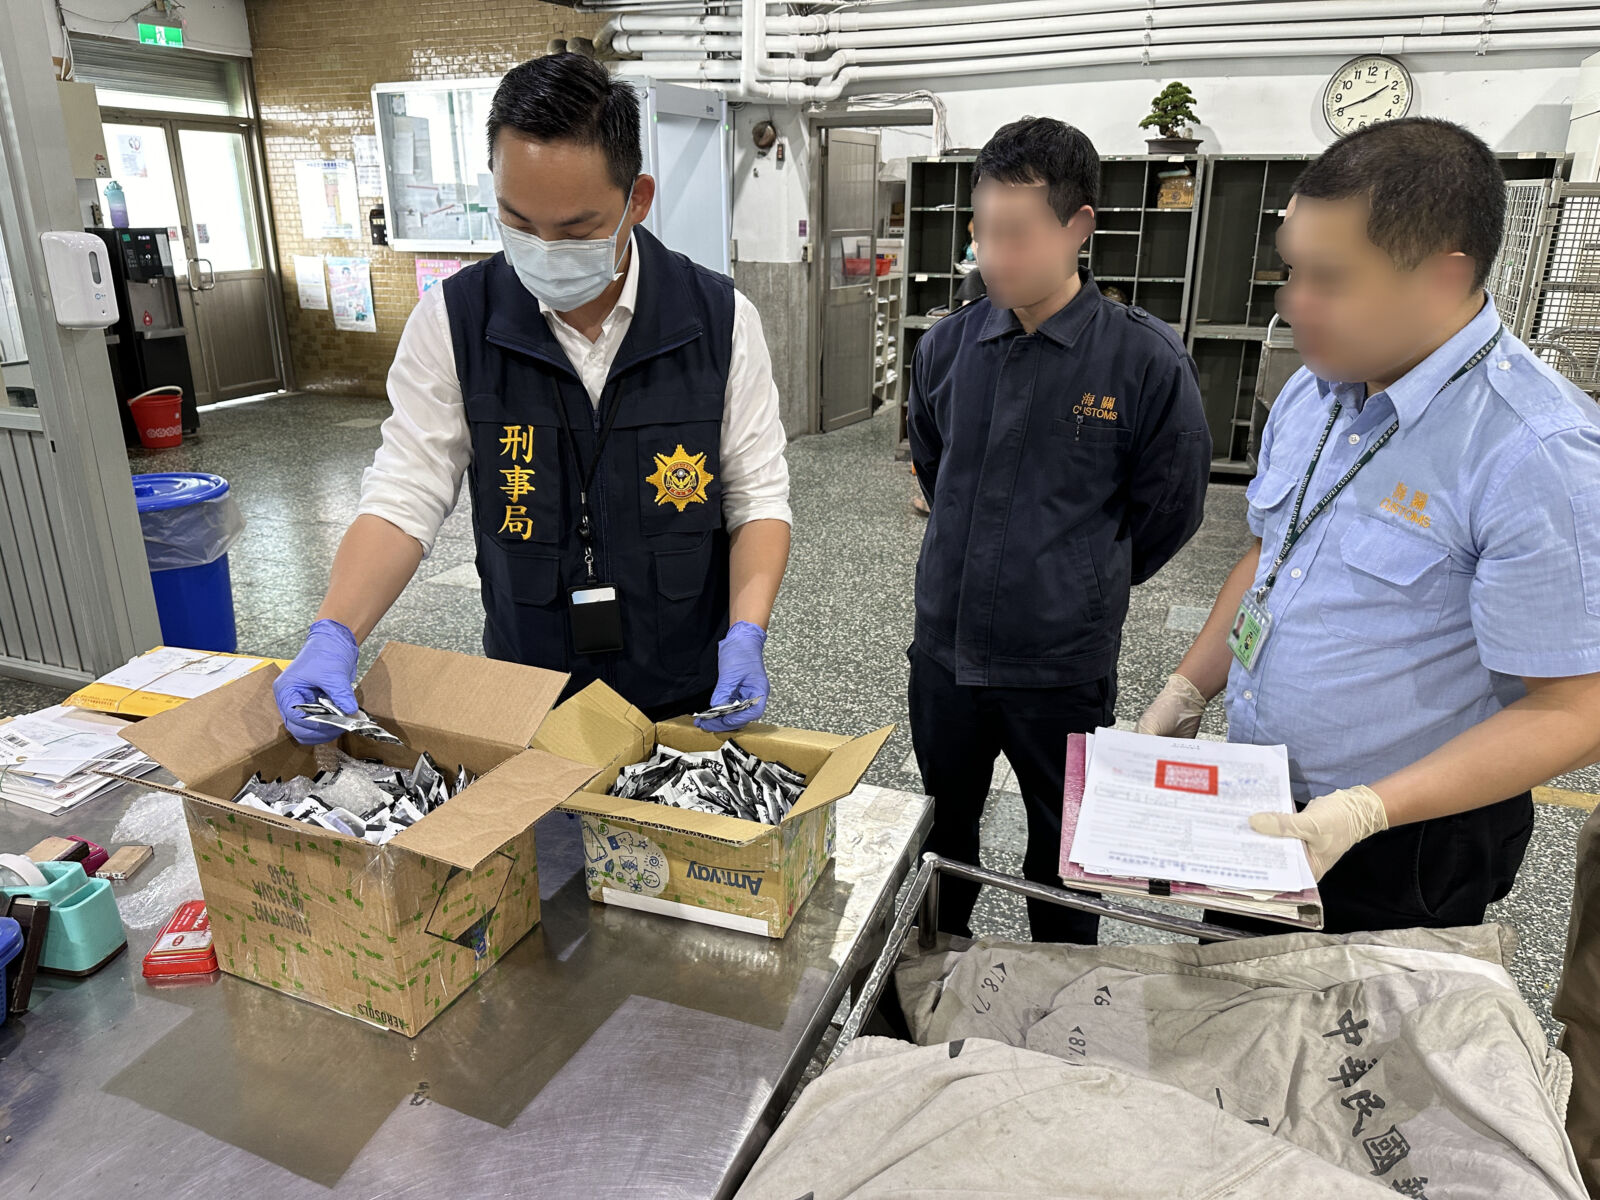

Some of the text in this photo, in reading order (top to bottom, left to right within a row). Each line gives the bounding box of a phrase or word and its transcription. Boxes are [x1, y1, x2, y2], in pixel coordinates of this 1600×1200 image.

[1354, 70, 1362, 80] 11
[1368, 66, 1379, 76] 12
[1384, 70, 1389, 80] 1
[1342, 80, 1353, 90] 10
[1391, 80, 1399, 90] 2
[1334, 93, 1343, 103] 9
[1392, 95, 1400, 104] 3
[1336, 107, 1345, 117] 8
[1384, 109, 1392, 118] 4
[1347, 118, 1354, 127] 7
[497, 424, 536, 541] 刑事局
[1320, 487, 1338, 506] TAIPEI
[1337, 463, 1361, 488] CUSTOMS
[1297, 474, 1310, 503] CUSTOMS
[1379, 497, 1431, 528] CUSTOMS
[686, 860, 764, 895] Amway
[357, 1003, 410, 1029] AEROSOLS
